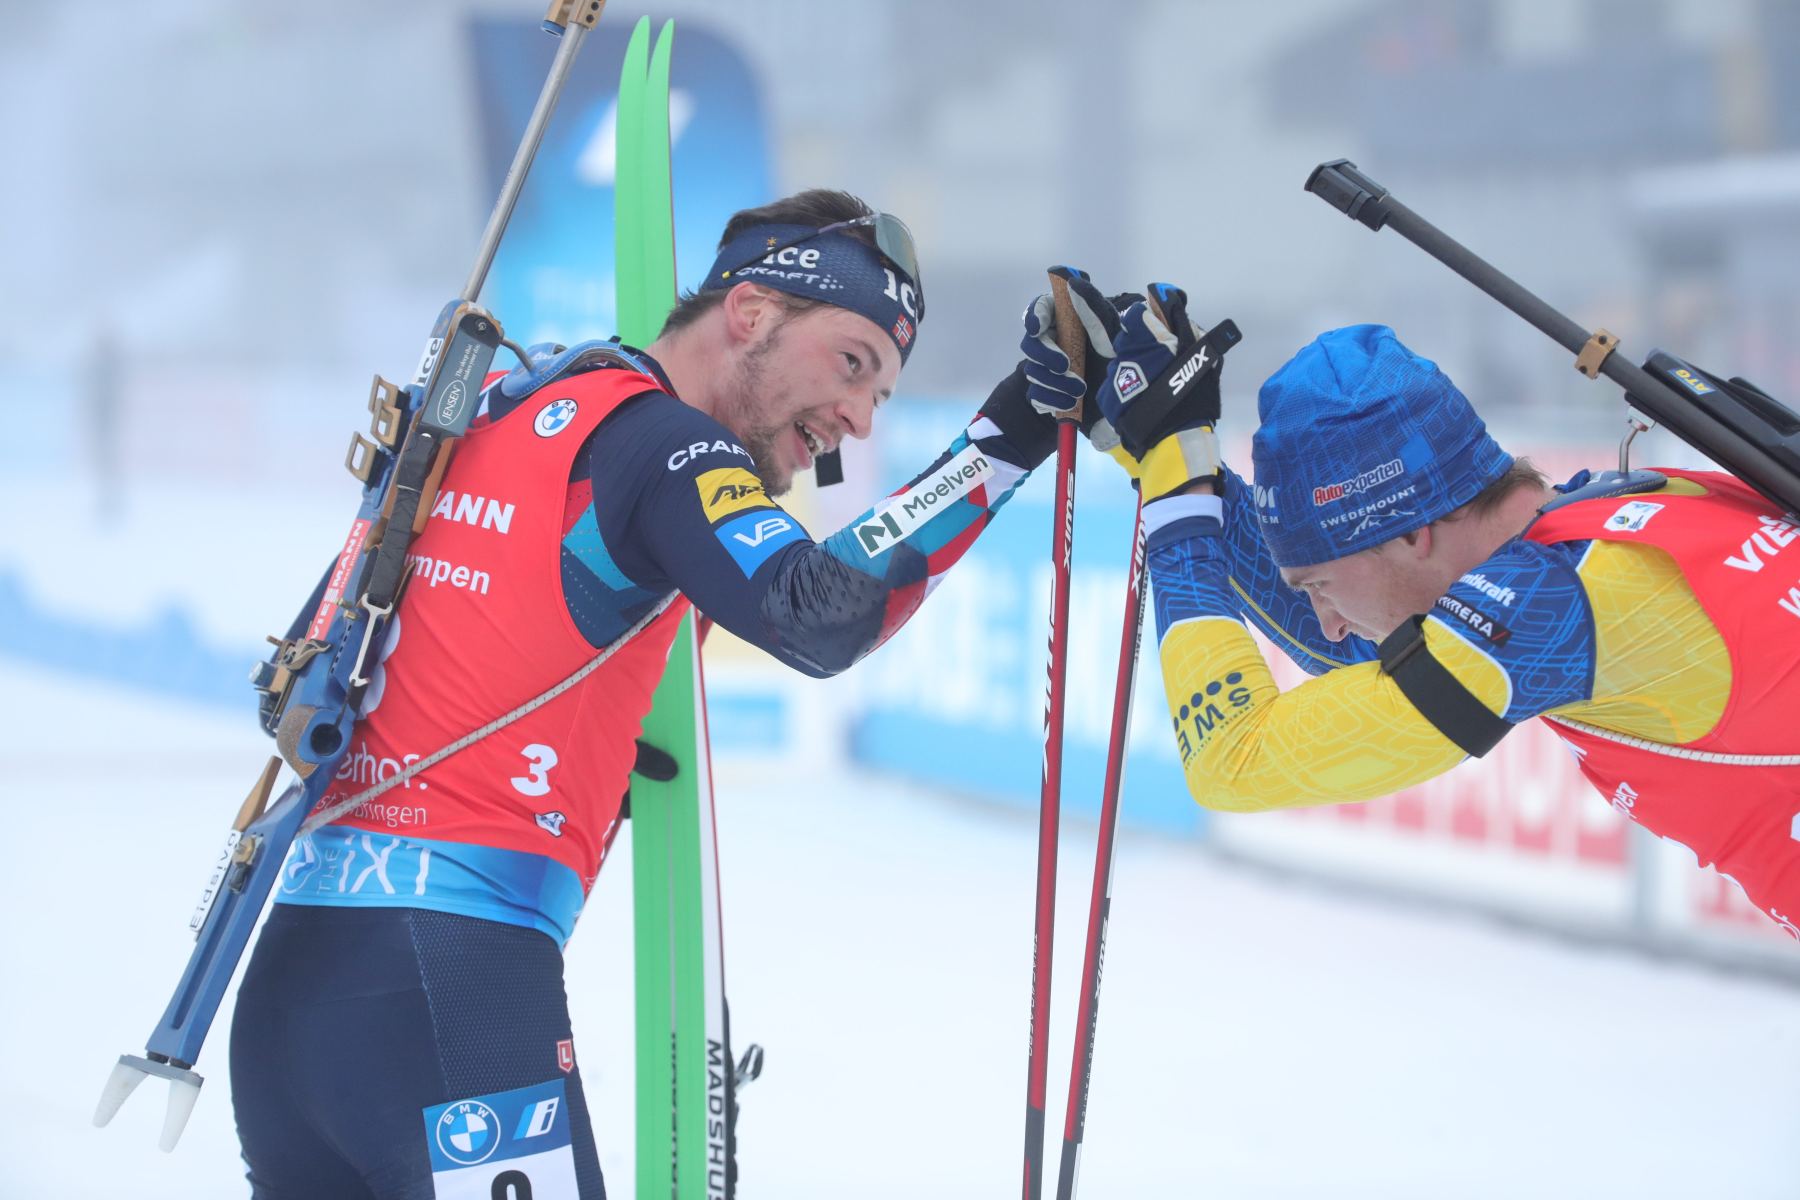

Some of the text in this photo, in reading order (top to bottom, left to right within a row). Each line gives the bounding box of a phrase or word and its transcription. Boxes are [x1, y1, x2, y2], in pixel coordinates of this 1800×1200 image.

[736, 267, 820, 284] CRAFT
[763, 246, 820, 269] ice
[1168, 345, 1209, 396] SWIX
[902, 456, 988, 519] Moelven
[1313, 459, 1404, 506] Autoexperten
[431, 490, 516, 534] ANN
[1320, 485, 1416, 529] SWEDEMOUNT
[1131, 519, 1146, 600] WIX
[510, 743, 559, 796] 3
[443, 1103, 490, 1125] BMW
